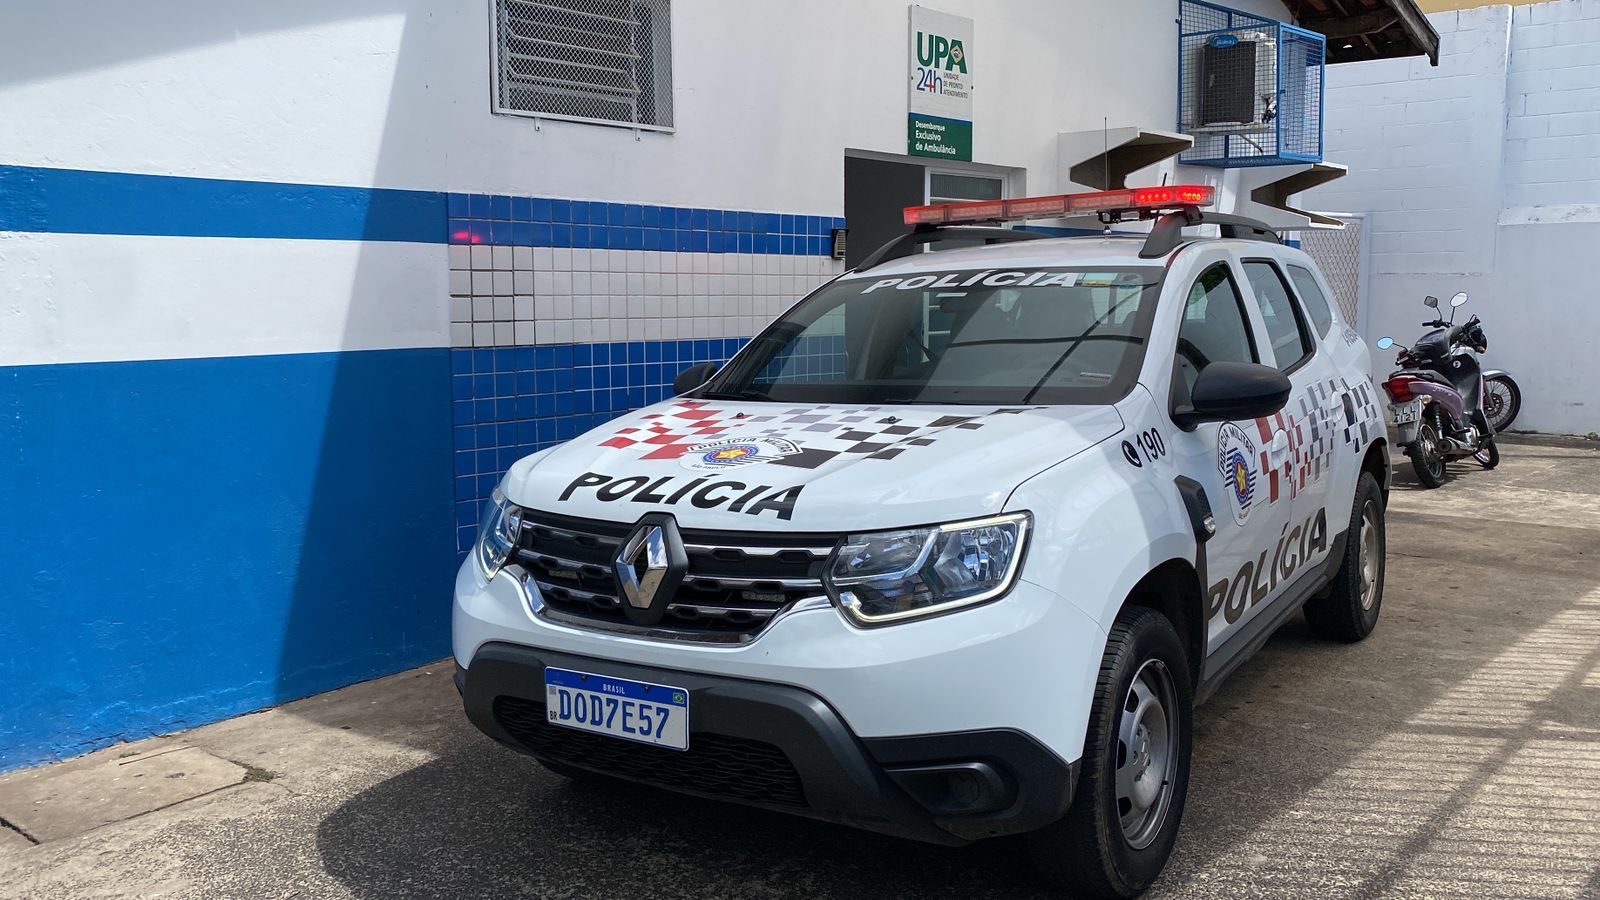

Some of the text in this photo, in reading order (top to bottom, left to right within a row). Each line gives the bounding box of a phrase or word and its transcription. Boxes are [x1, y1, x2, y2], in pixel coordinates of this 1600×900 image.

[917, 32, 968, 74] UPA
[917, 67, 942, 94] 24h
[948, 81, 963, 90] PRONTO
[943, 89, 968, 99] ATENDIMENTO
[915, 120, 946, 132] Desembarque
[915, 130, 942, 142] Exclusivo
[915, 141, 956, 155] de Ambulância
[860, 270, 1082, 294] POLÍCIA
[1136, 427, 1166, 463] 190
[558, 471, 806, 521] POLÍCIA
[1207, 507, 1328, 625] POLÍCIA
[602, 683, 626, 695] BRASIL
[549, 710, 558, 721] BR
[558, 689, 670, 739] DOD7E57
